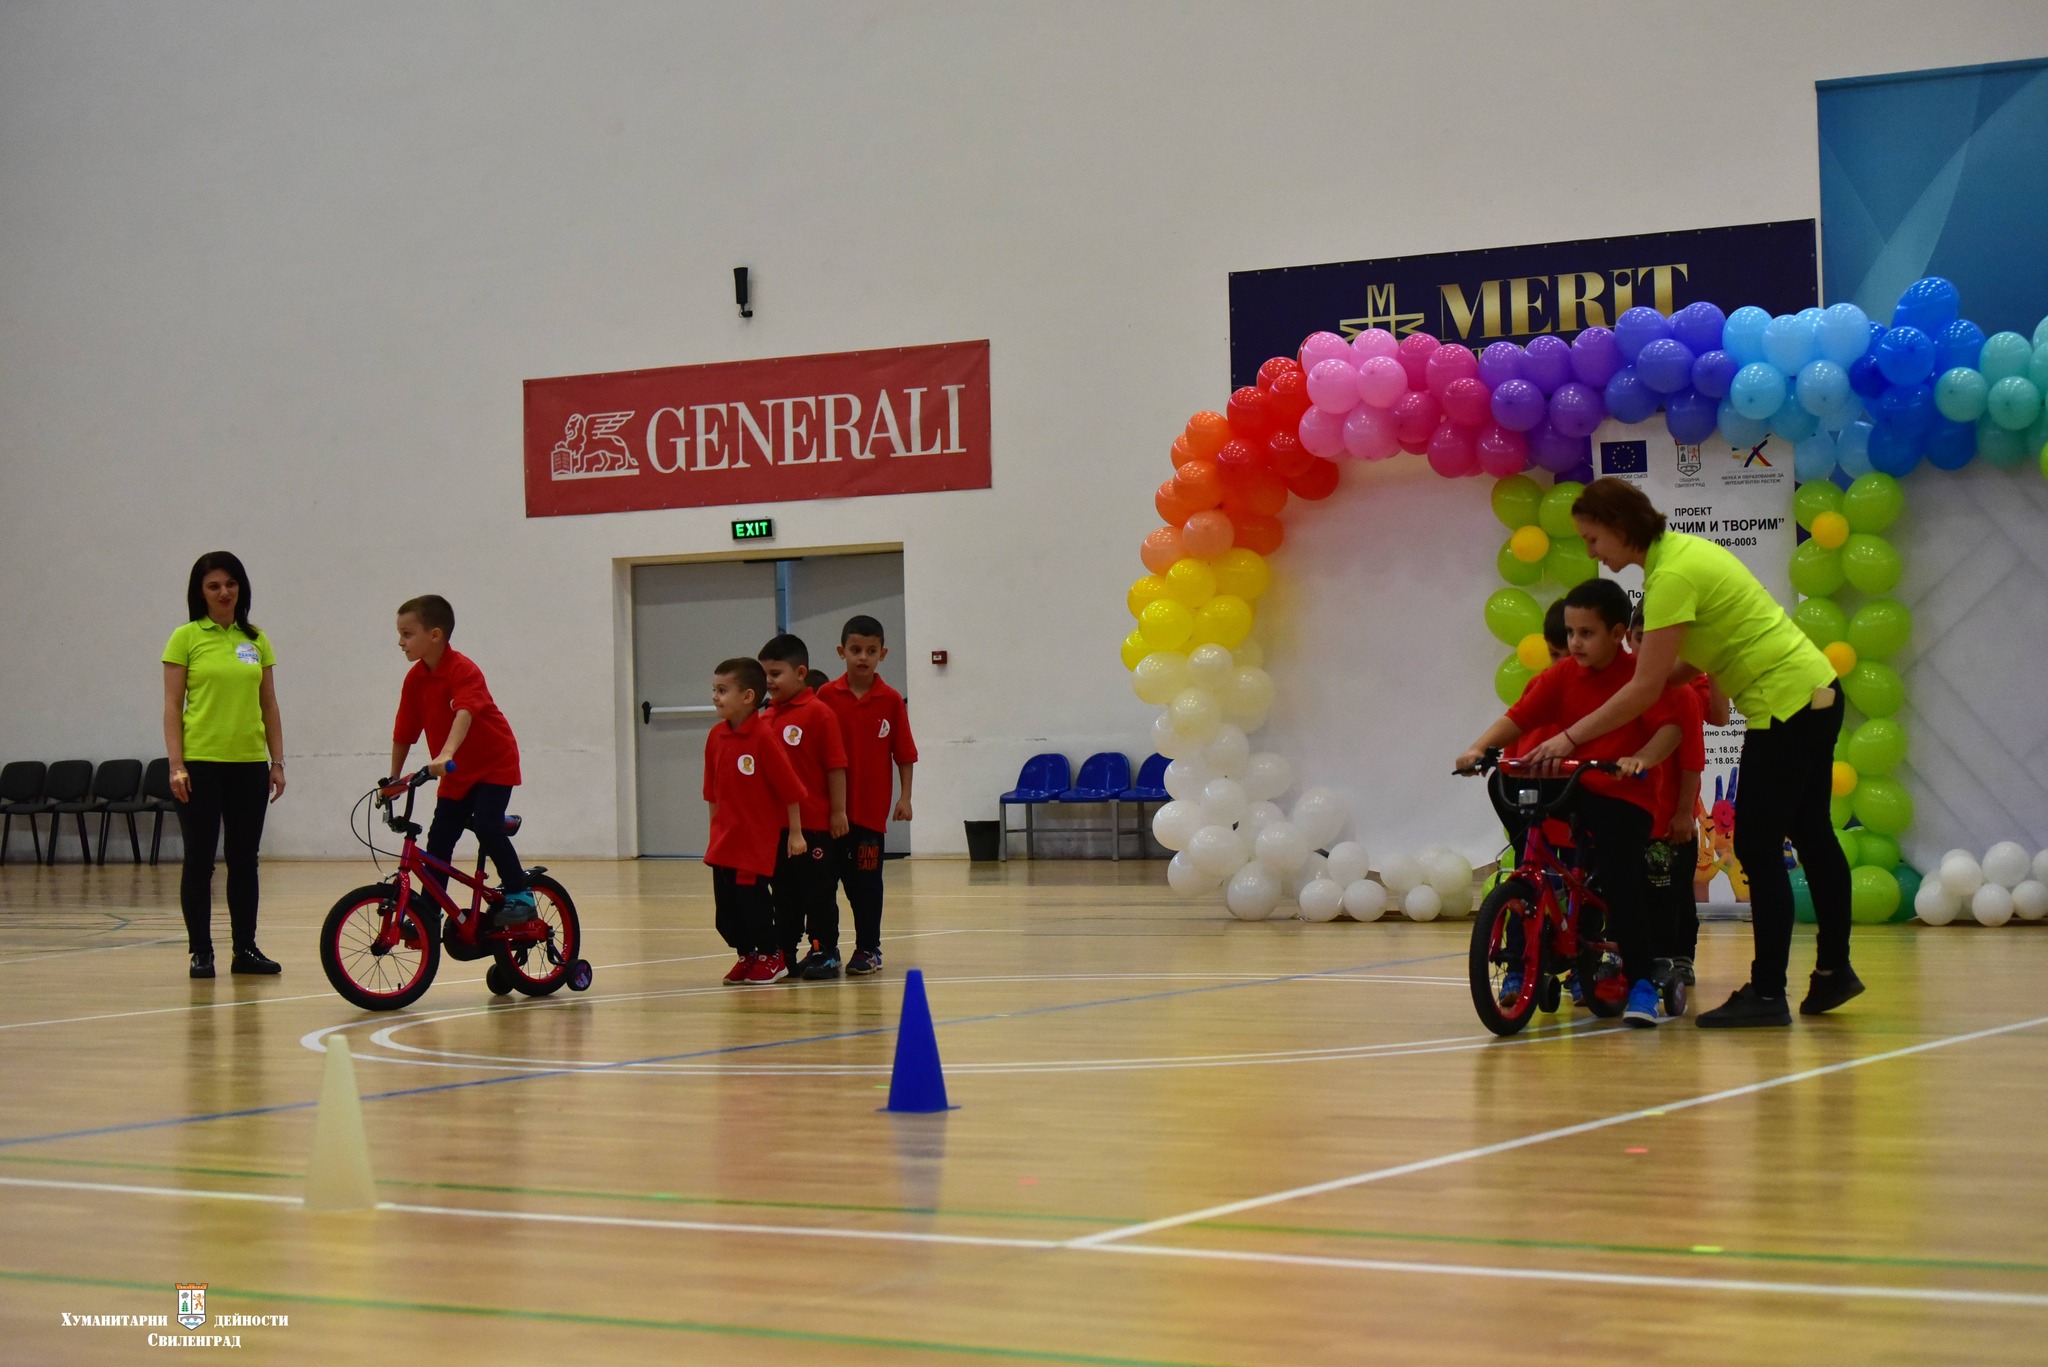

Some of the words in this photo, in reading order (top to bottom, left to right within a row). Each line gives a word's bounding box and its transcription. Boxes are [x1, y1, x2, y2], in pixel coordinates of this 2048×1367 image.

[646, 384, 967, 474] GENERALI
[1674, 507, 1713, 517] ПРОЕКТ
[735, 521, 768, 537] EXIT
[1669, 521, 1706, 533] УЧИМ
[1710, 521, 1719, 532] И
[1708, 537, 1757, 547] 006-0003
